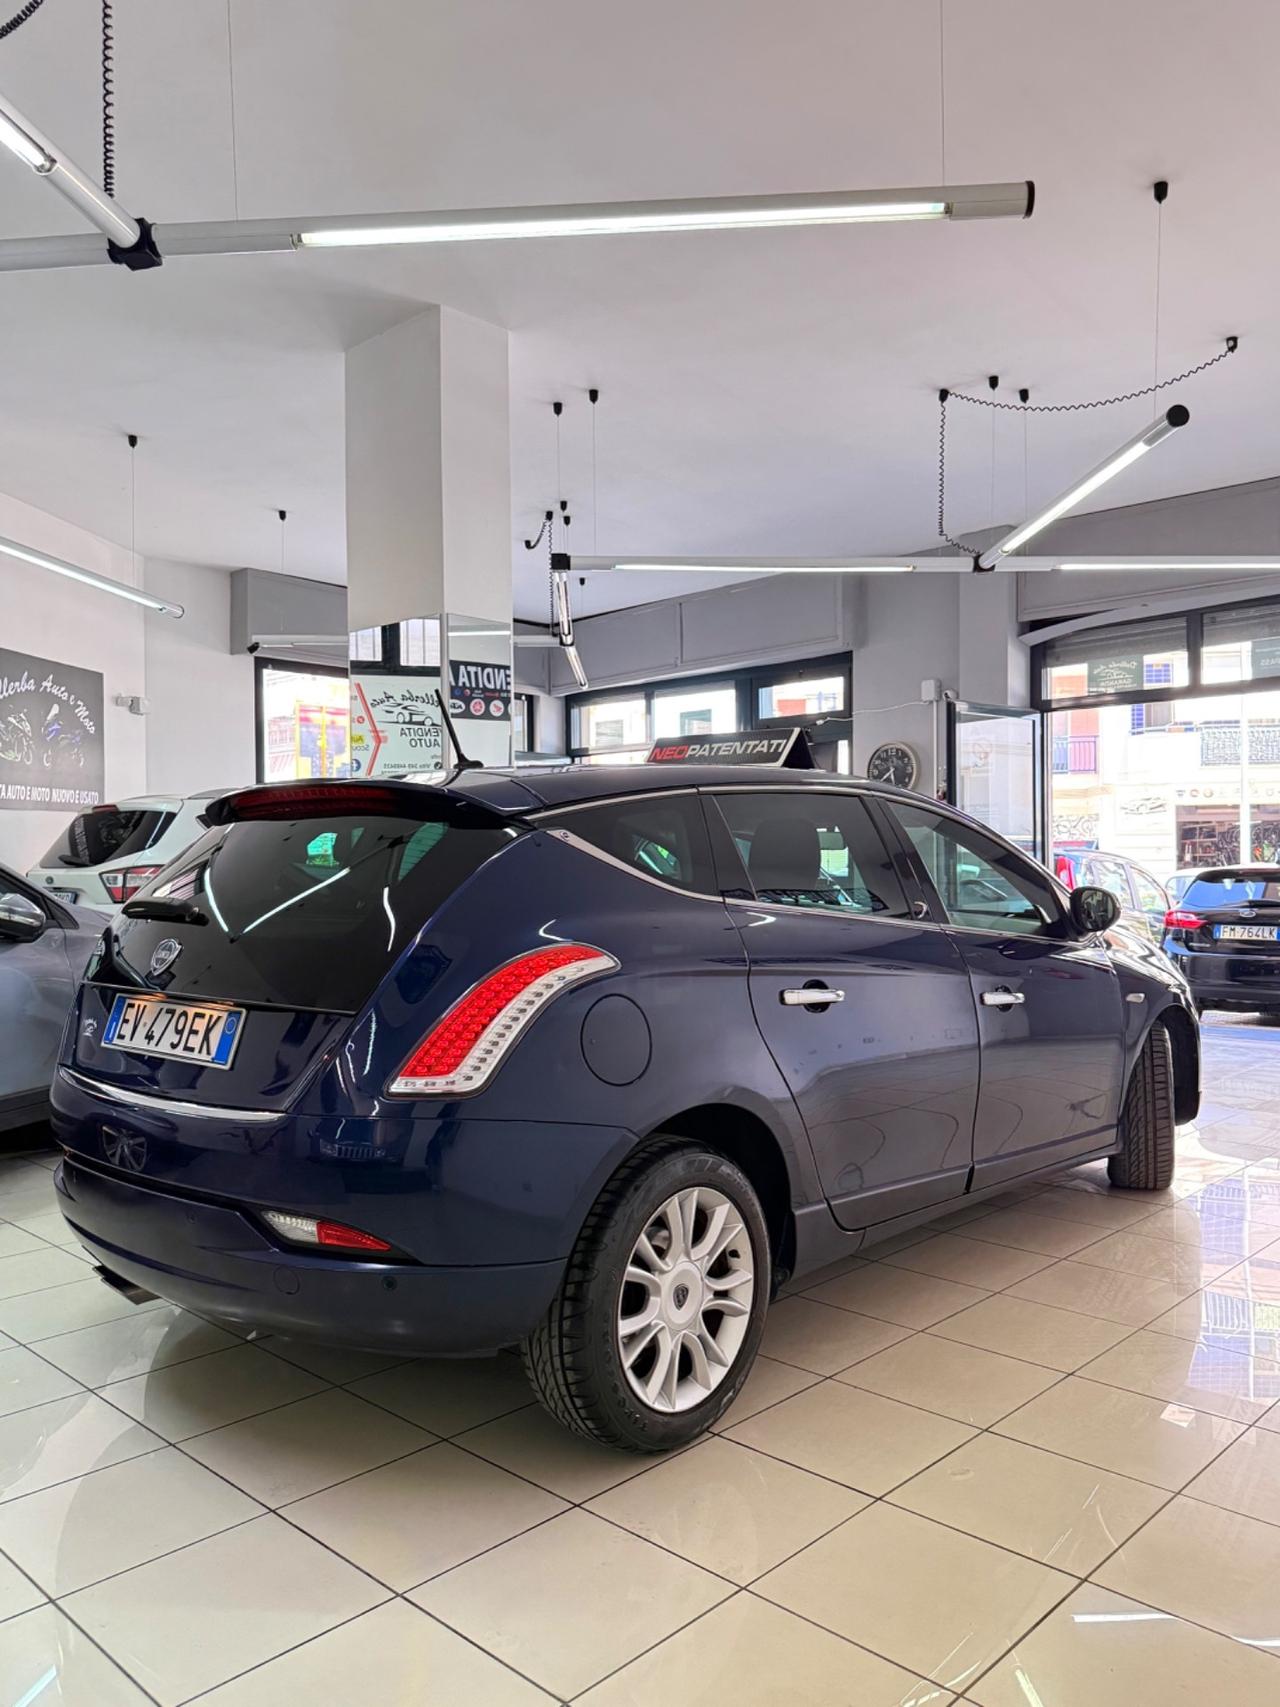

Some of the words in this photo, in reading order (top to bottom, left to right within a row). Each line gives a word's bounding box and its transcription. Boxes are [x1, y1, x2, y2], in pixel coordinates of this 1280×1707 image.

[39, 673, 68, 700] Auto
[75, 700, 96, 734] Moto
[650, 739, 787, 760] NEOPATENTATI
[7, 785, 26, 801] AUTO
[31, 787, 50, 802] MOTO
[51, 788, 75, 803] NUOVO
[80, 790, 99, 805] USATO
[1223, 926, 1236, 937] FM
[1240, 927, 1276, 939] 764LK
[117, 1002, 147, 1041] EV
[144, 1008, 222, 1055] 479EK
